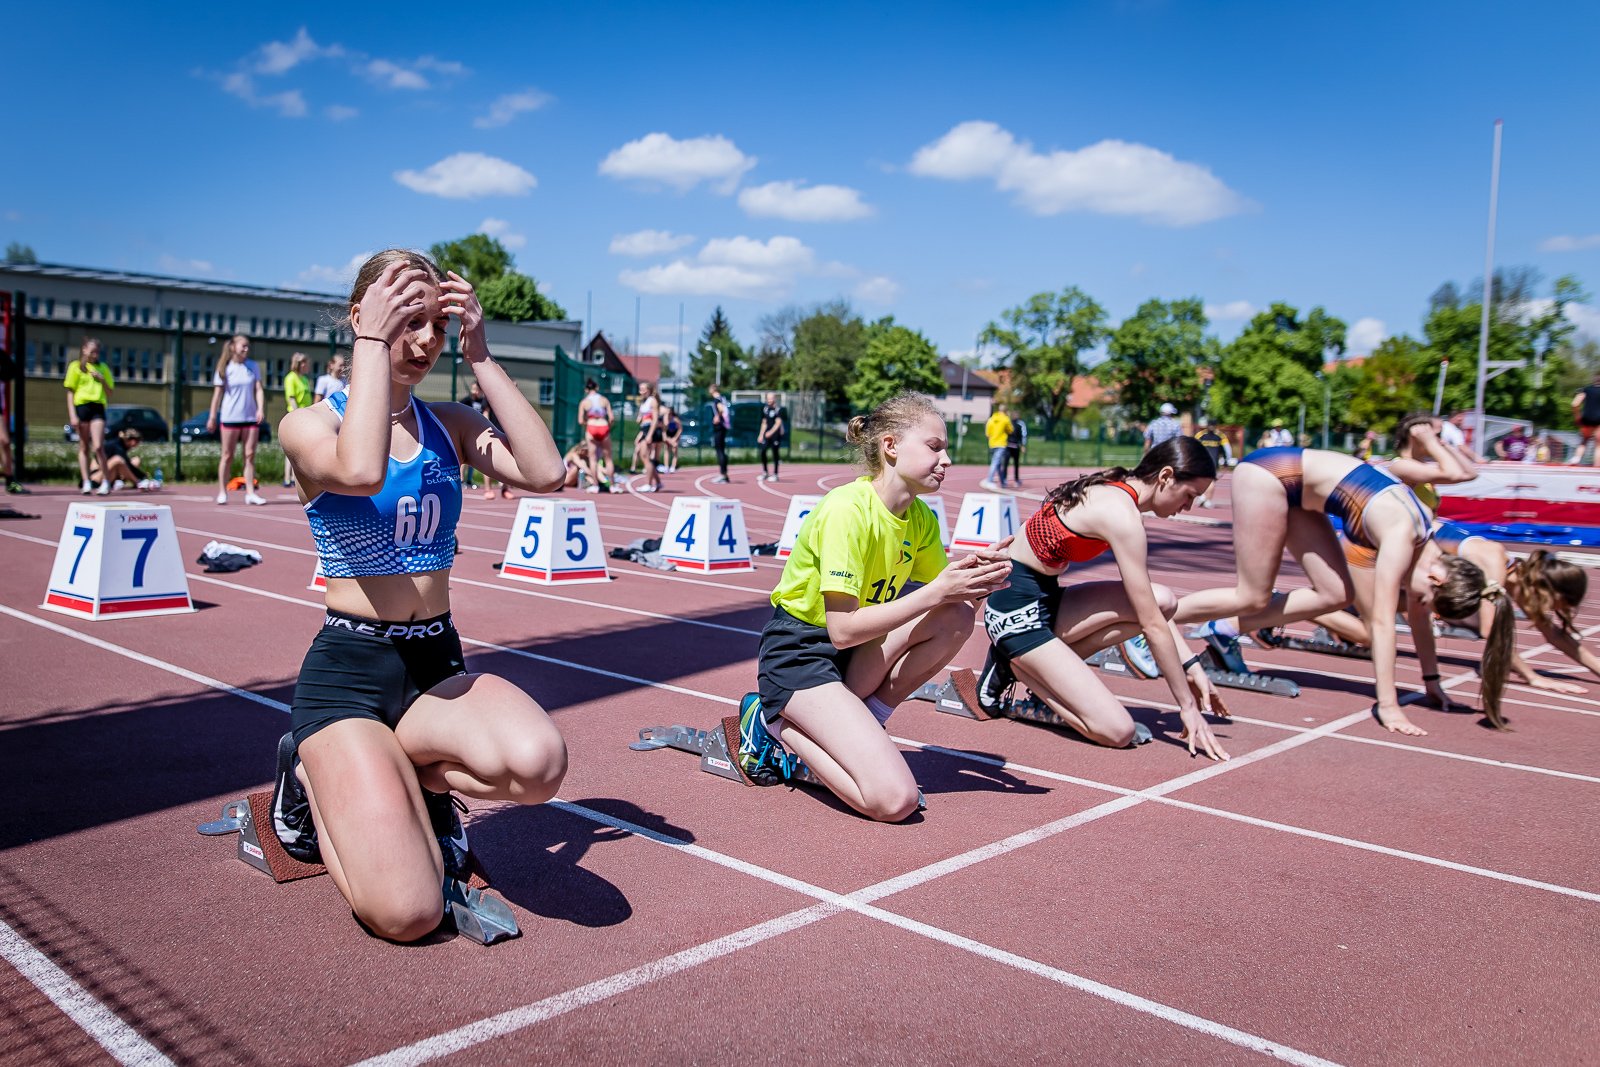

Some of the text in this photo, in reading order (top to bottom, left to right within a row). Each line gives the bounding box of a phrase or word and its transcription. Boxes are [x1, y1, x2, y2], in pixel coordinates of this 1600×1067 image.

[394, 493, 441, 547] 60
[521, 515, 542, 559] 5
[566, 517, 588, 562] 5
[675, 513, 696, 552] 4
[718, 514, 737, 553] 4
[972, 506, 985, 535] 1
[1003, 506, 1013, 536] 1
[69, 526, 93, 585] 7
[121, 528, 159, 588] 7
[866, 575, 897, 604] 16
[384, 621, 445, 640] PRO
[990, 613, 1024, 639] NIKE
